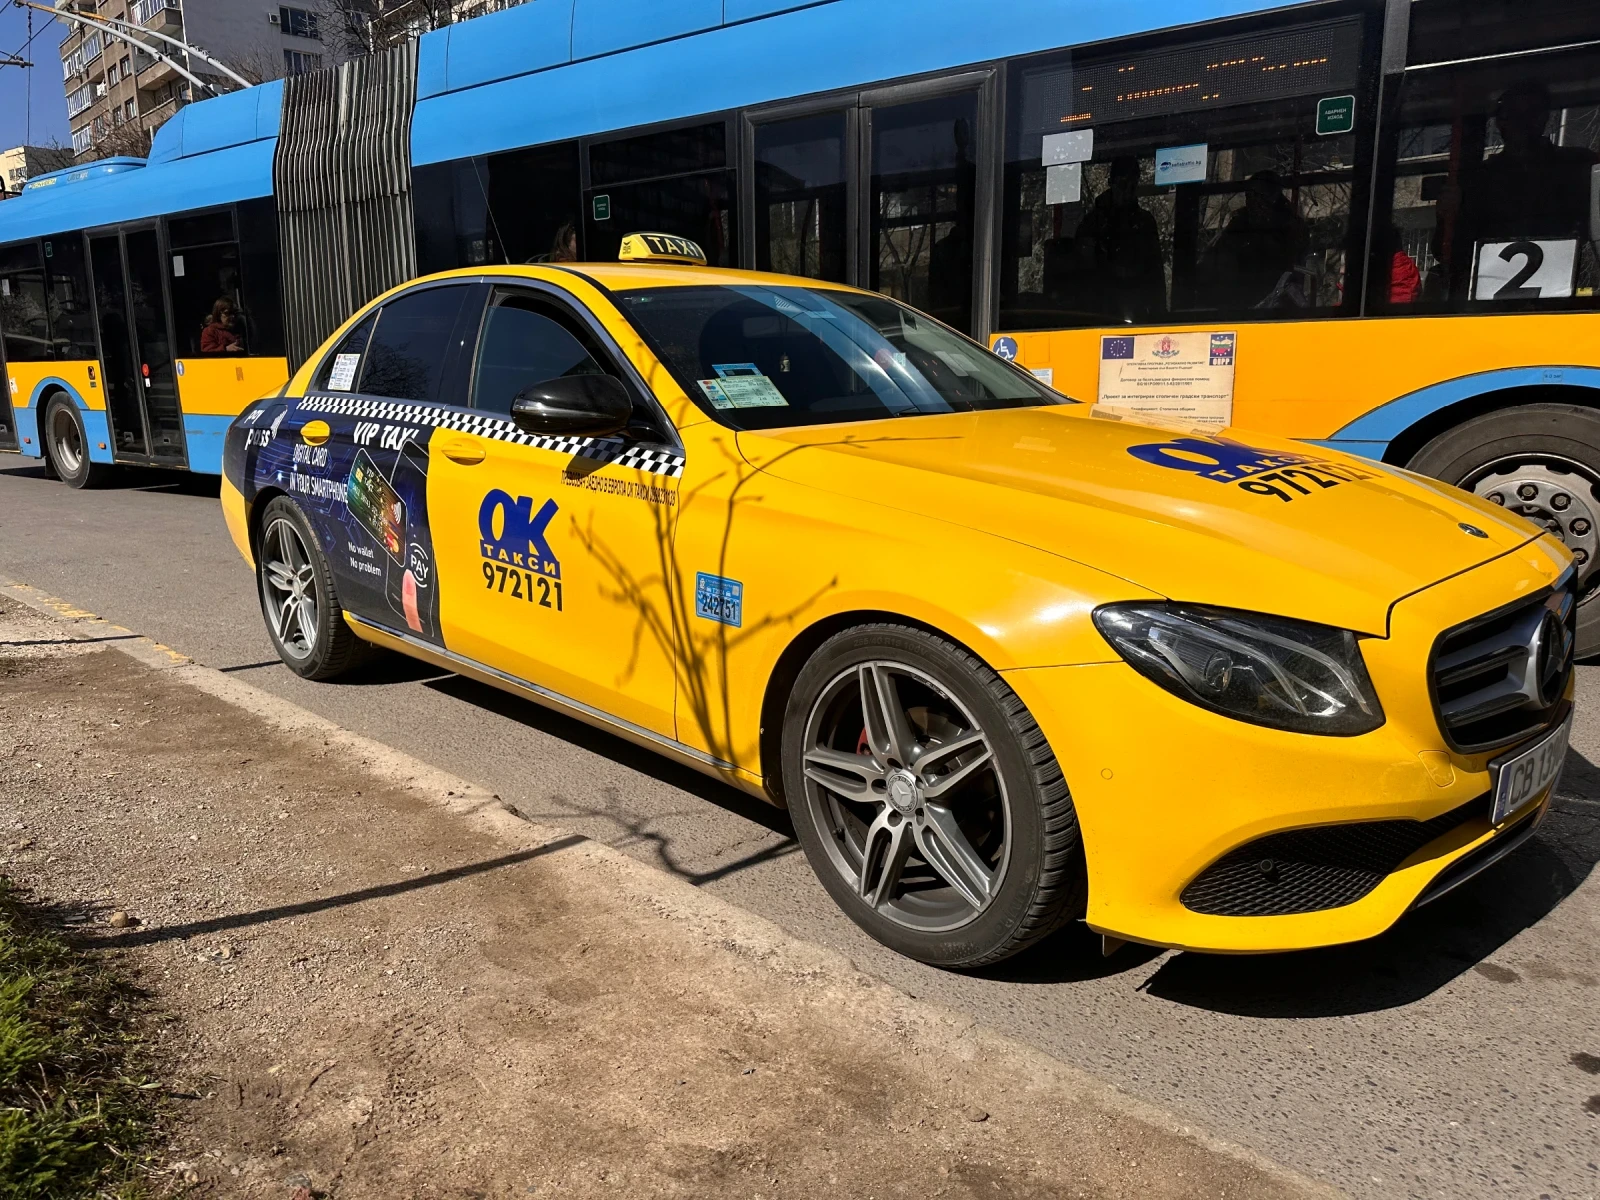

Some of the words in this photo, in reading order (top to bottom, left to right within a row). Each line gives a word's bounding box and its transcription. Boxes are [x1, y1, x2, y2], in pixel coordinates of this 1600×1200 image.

[647, 236, 699, 257] TAXI
[1493, 241, 1544, 300] 2
[244, 428, 271, 451] pass
[353, 421, 380, 445] VIP
[293, 443, 313, 464] DIGITAL
[312, 446, 328, 467] CARD
[1209, 454, 1320, 479] ТАКСИ
[289, 472, 297, 490] IN
[296, 472, 311, 495] YOUR
[311, 476, 349, 504] SMARTPHONE
[1237, 462, 1383, 503] 972121
[348, 541, 357, 553] No
[356, 545, 375, 559] wallet
[483, 543, 556, 575] ТАКСИ
[349, 556, 358, 569] No
[358, 561, 382, 577] problem
[410, 553, 429, 579] PAY
[482, 561, 563, 612] 972121
[702, 593, 736, 620] 242751
[1509, 757, 1535, 805] CB
